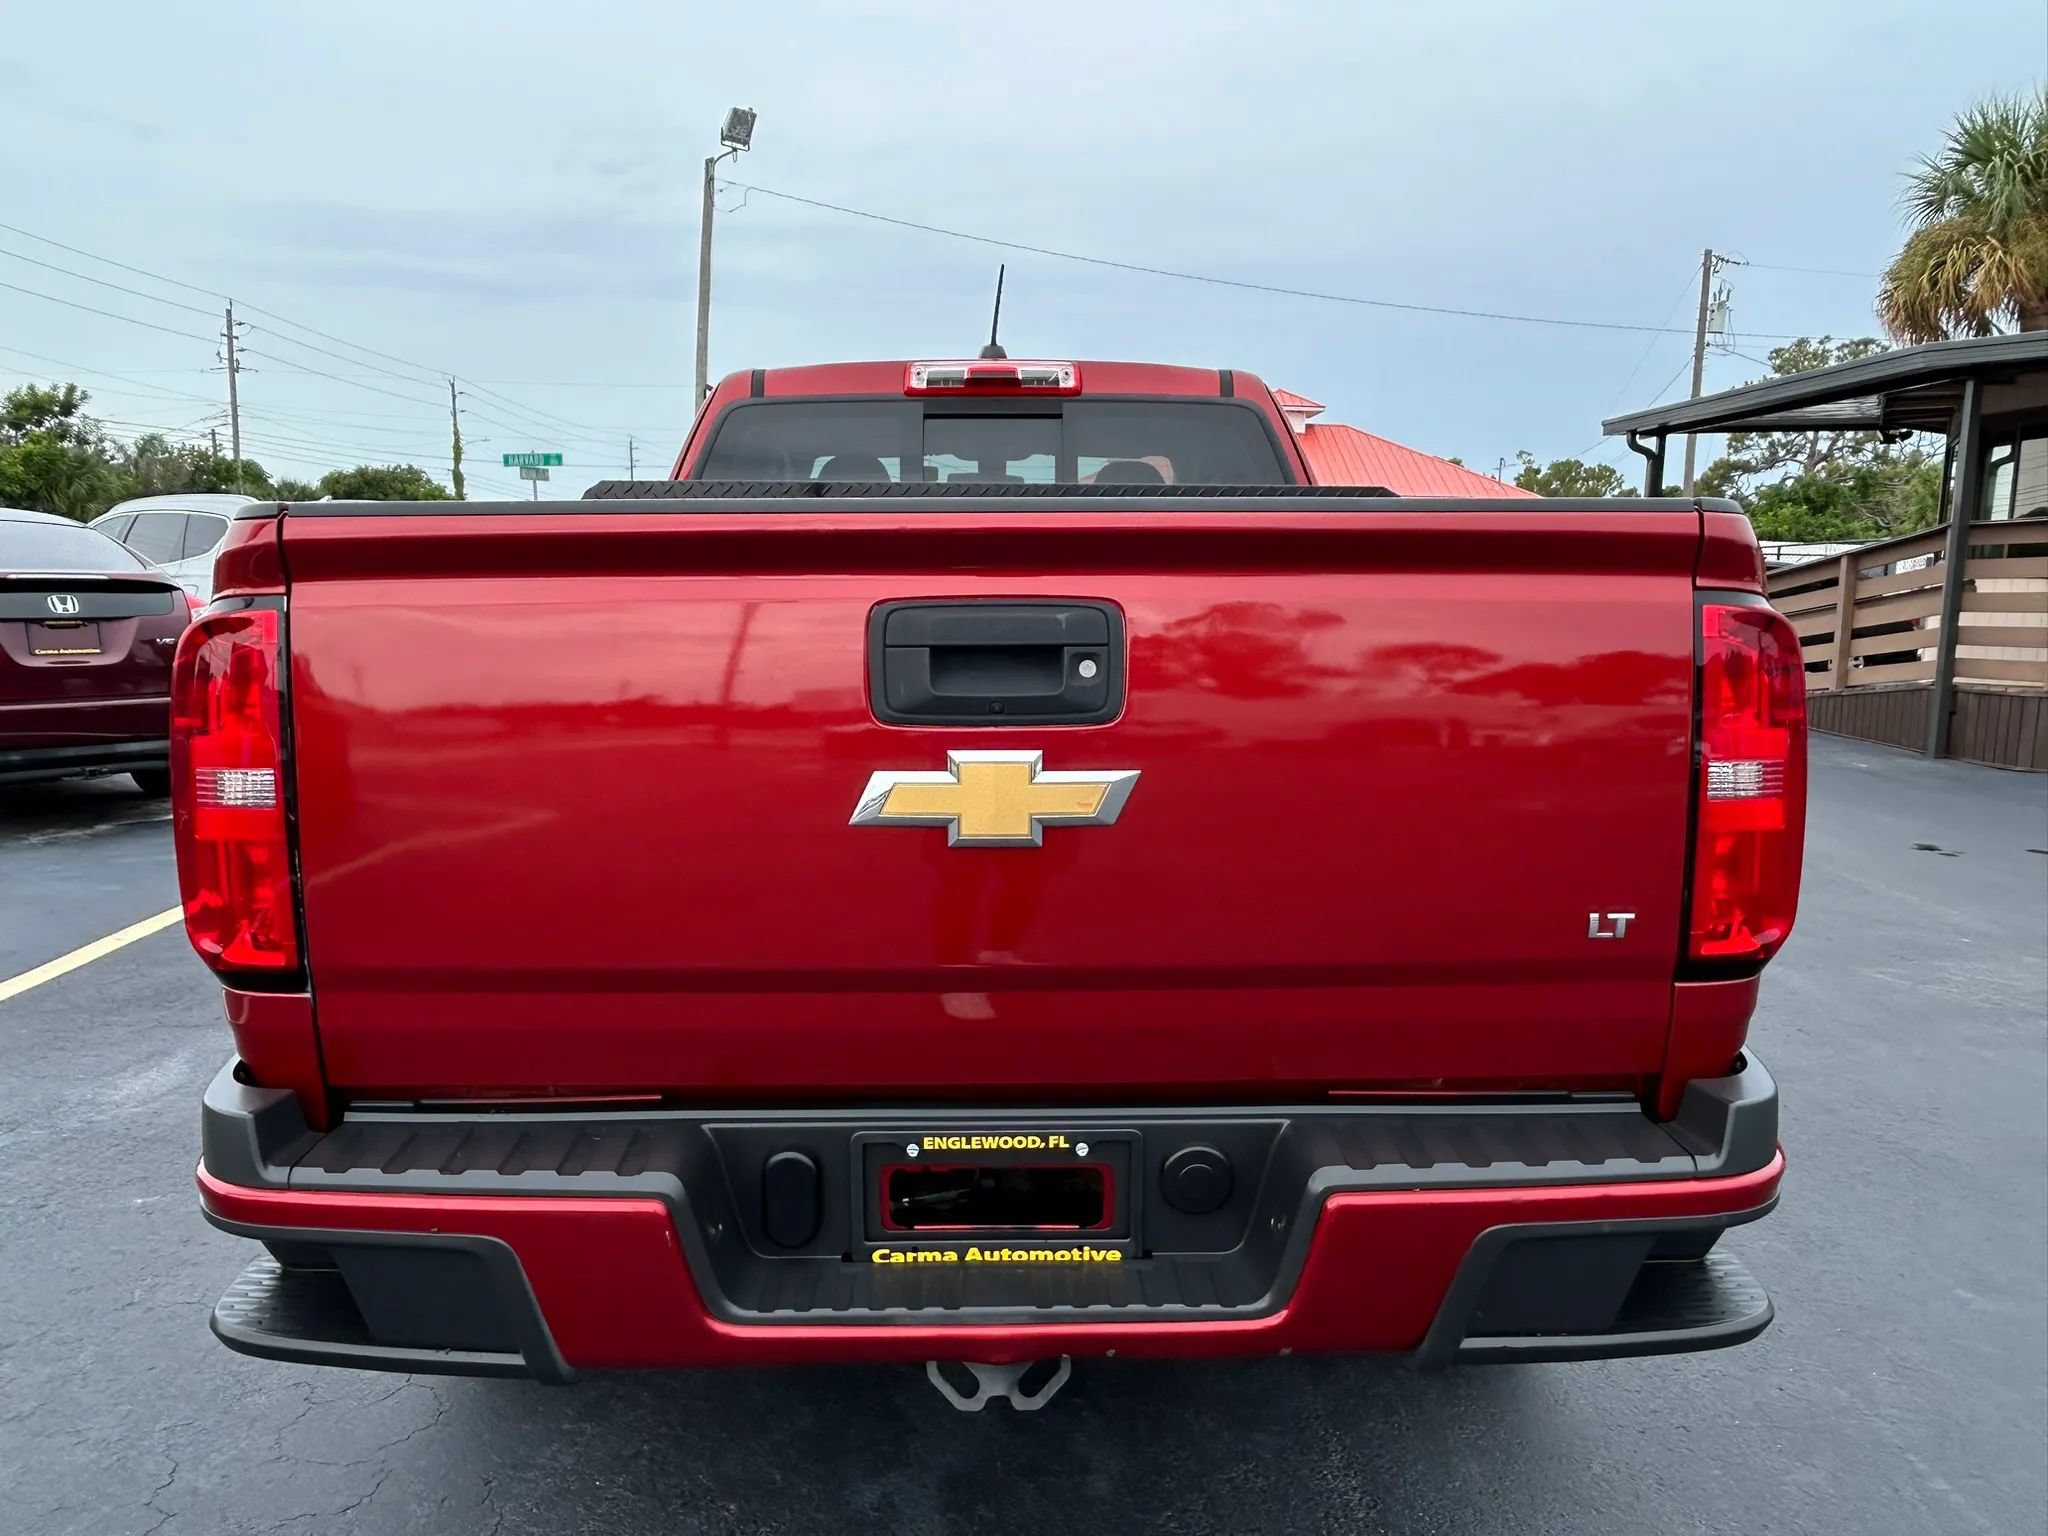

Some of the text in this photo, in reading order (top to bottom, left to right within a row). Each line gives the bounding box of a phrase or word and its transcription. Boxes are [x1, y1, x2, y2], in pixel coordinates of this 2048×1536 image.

[508, 454, 545, 466] HARVARD
[1588, 912, 1636, 938] LT
[923, 1135, 1070, 1150] ENGLEWOOD, FL
[871, 1246, 1122, 1263] Carma Automotive
